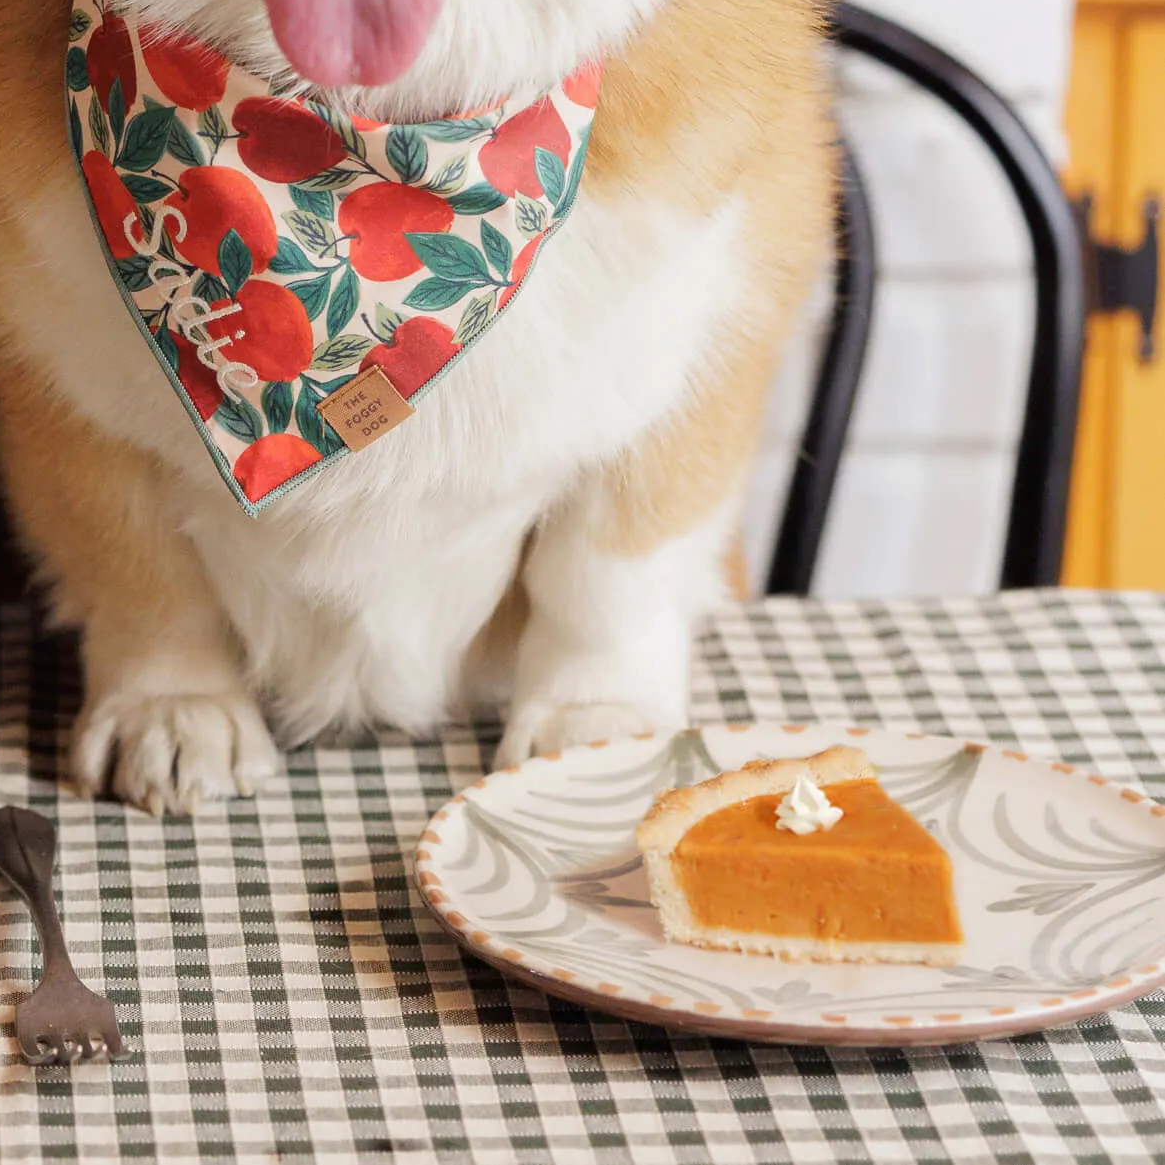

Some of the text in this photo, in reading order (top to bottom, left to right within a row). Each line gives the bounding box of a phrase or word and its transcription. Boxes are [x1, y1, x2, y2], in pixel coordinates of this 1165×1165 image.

[123, 205, 259, 405] Sadie
[343, 390, 366, 409] THE
[345, 397, 382, 429] FOGGY
[361, 414, 389, 436] DOG
